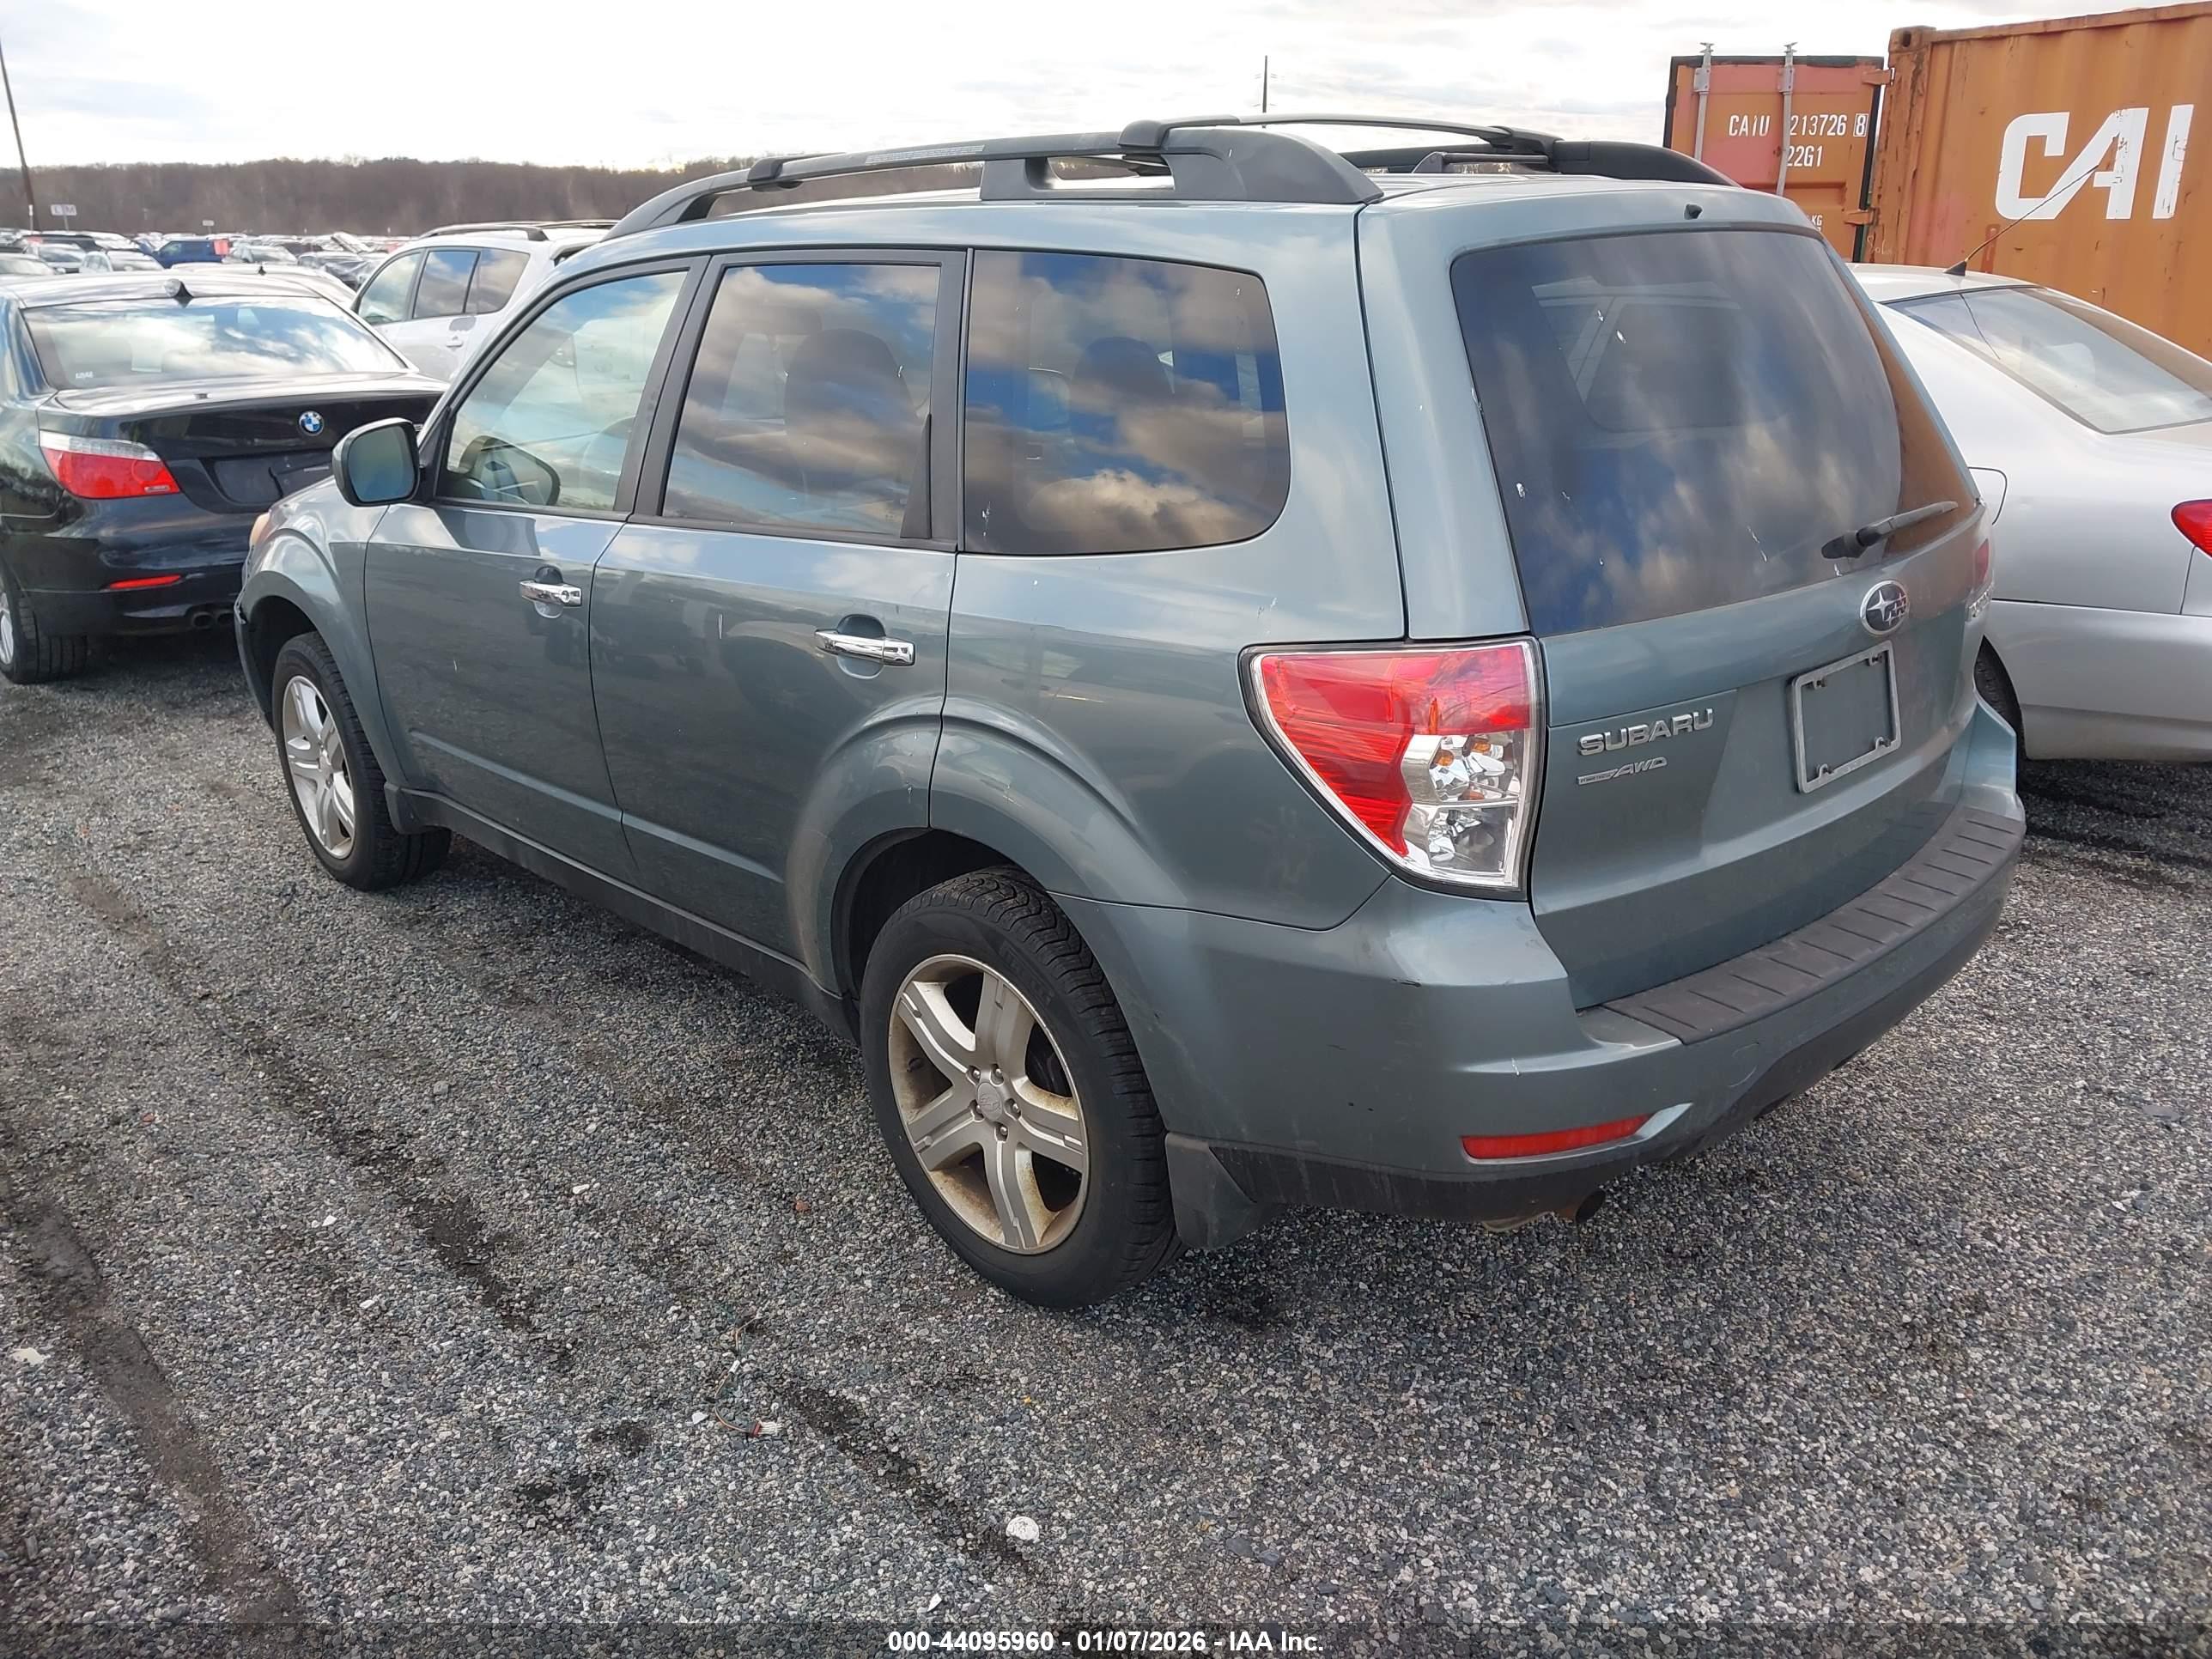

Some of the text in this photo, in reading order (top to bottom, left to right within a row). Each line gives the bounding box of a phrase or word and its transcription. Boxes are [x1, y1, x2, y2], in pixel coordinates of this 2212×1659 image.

[1729, 113, 1869, 137] CAIU 213726 8
[1996, 104, 2195, 220] CAI
[1578, 708, 1714, 756] SUBARU
[1613, 757, 1668, 778] AWD
